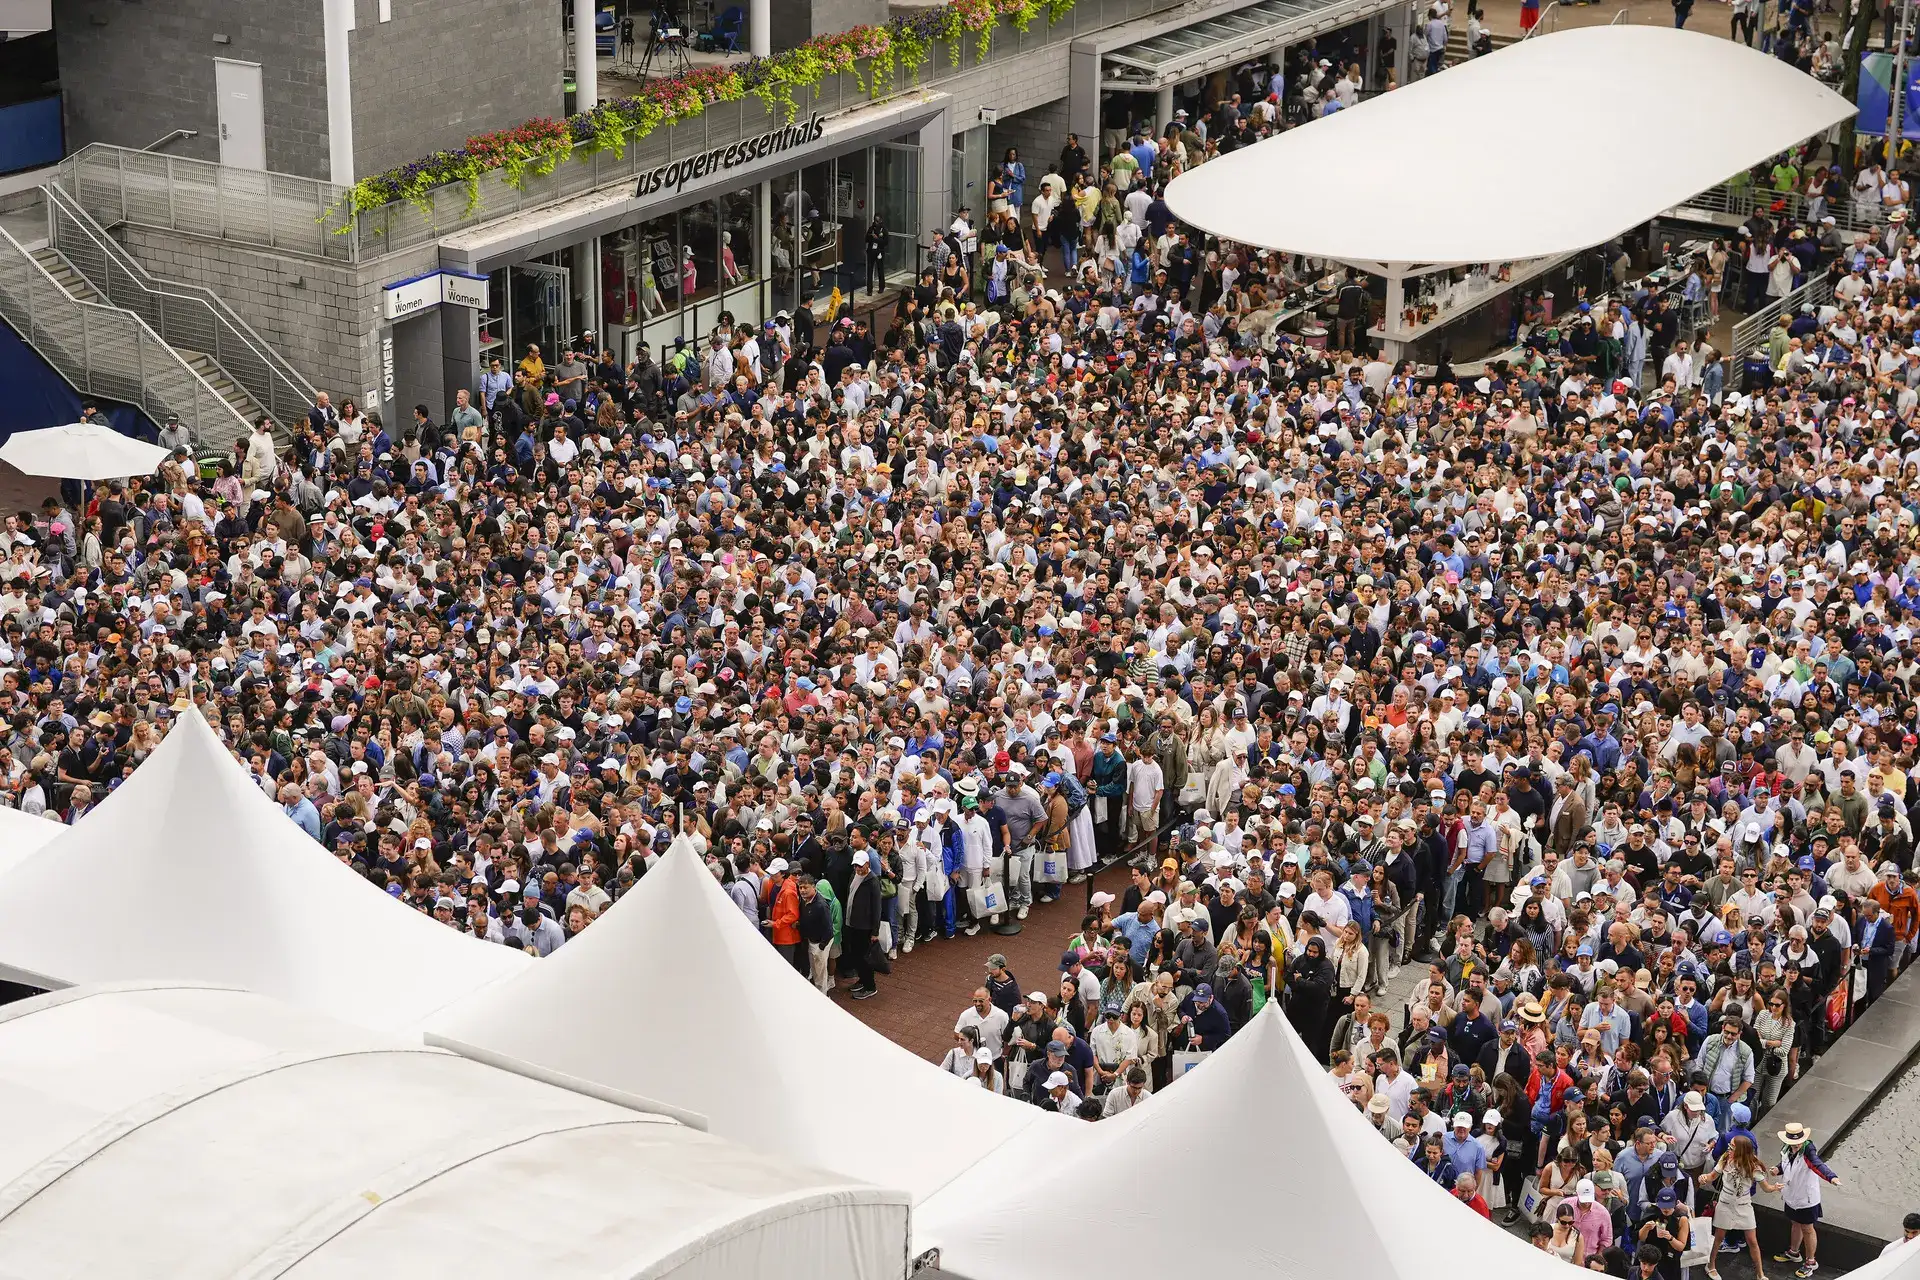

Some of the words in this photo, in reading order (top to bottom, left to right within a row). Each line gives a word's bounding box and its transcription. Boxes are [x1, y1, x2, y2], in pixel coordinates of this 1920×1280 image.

[636, 166, 667, 198] us
[664, 149, 722, 193] open
[723, 111, 825, 169] essentials
[395, 297, 422, 313] Women
[448, 290, 480, 306] Women
[383, 337, 394, 402] WOMEN
